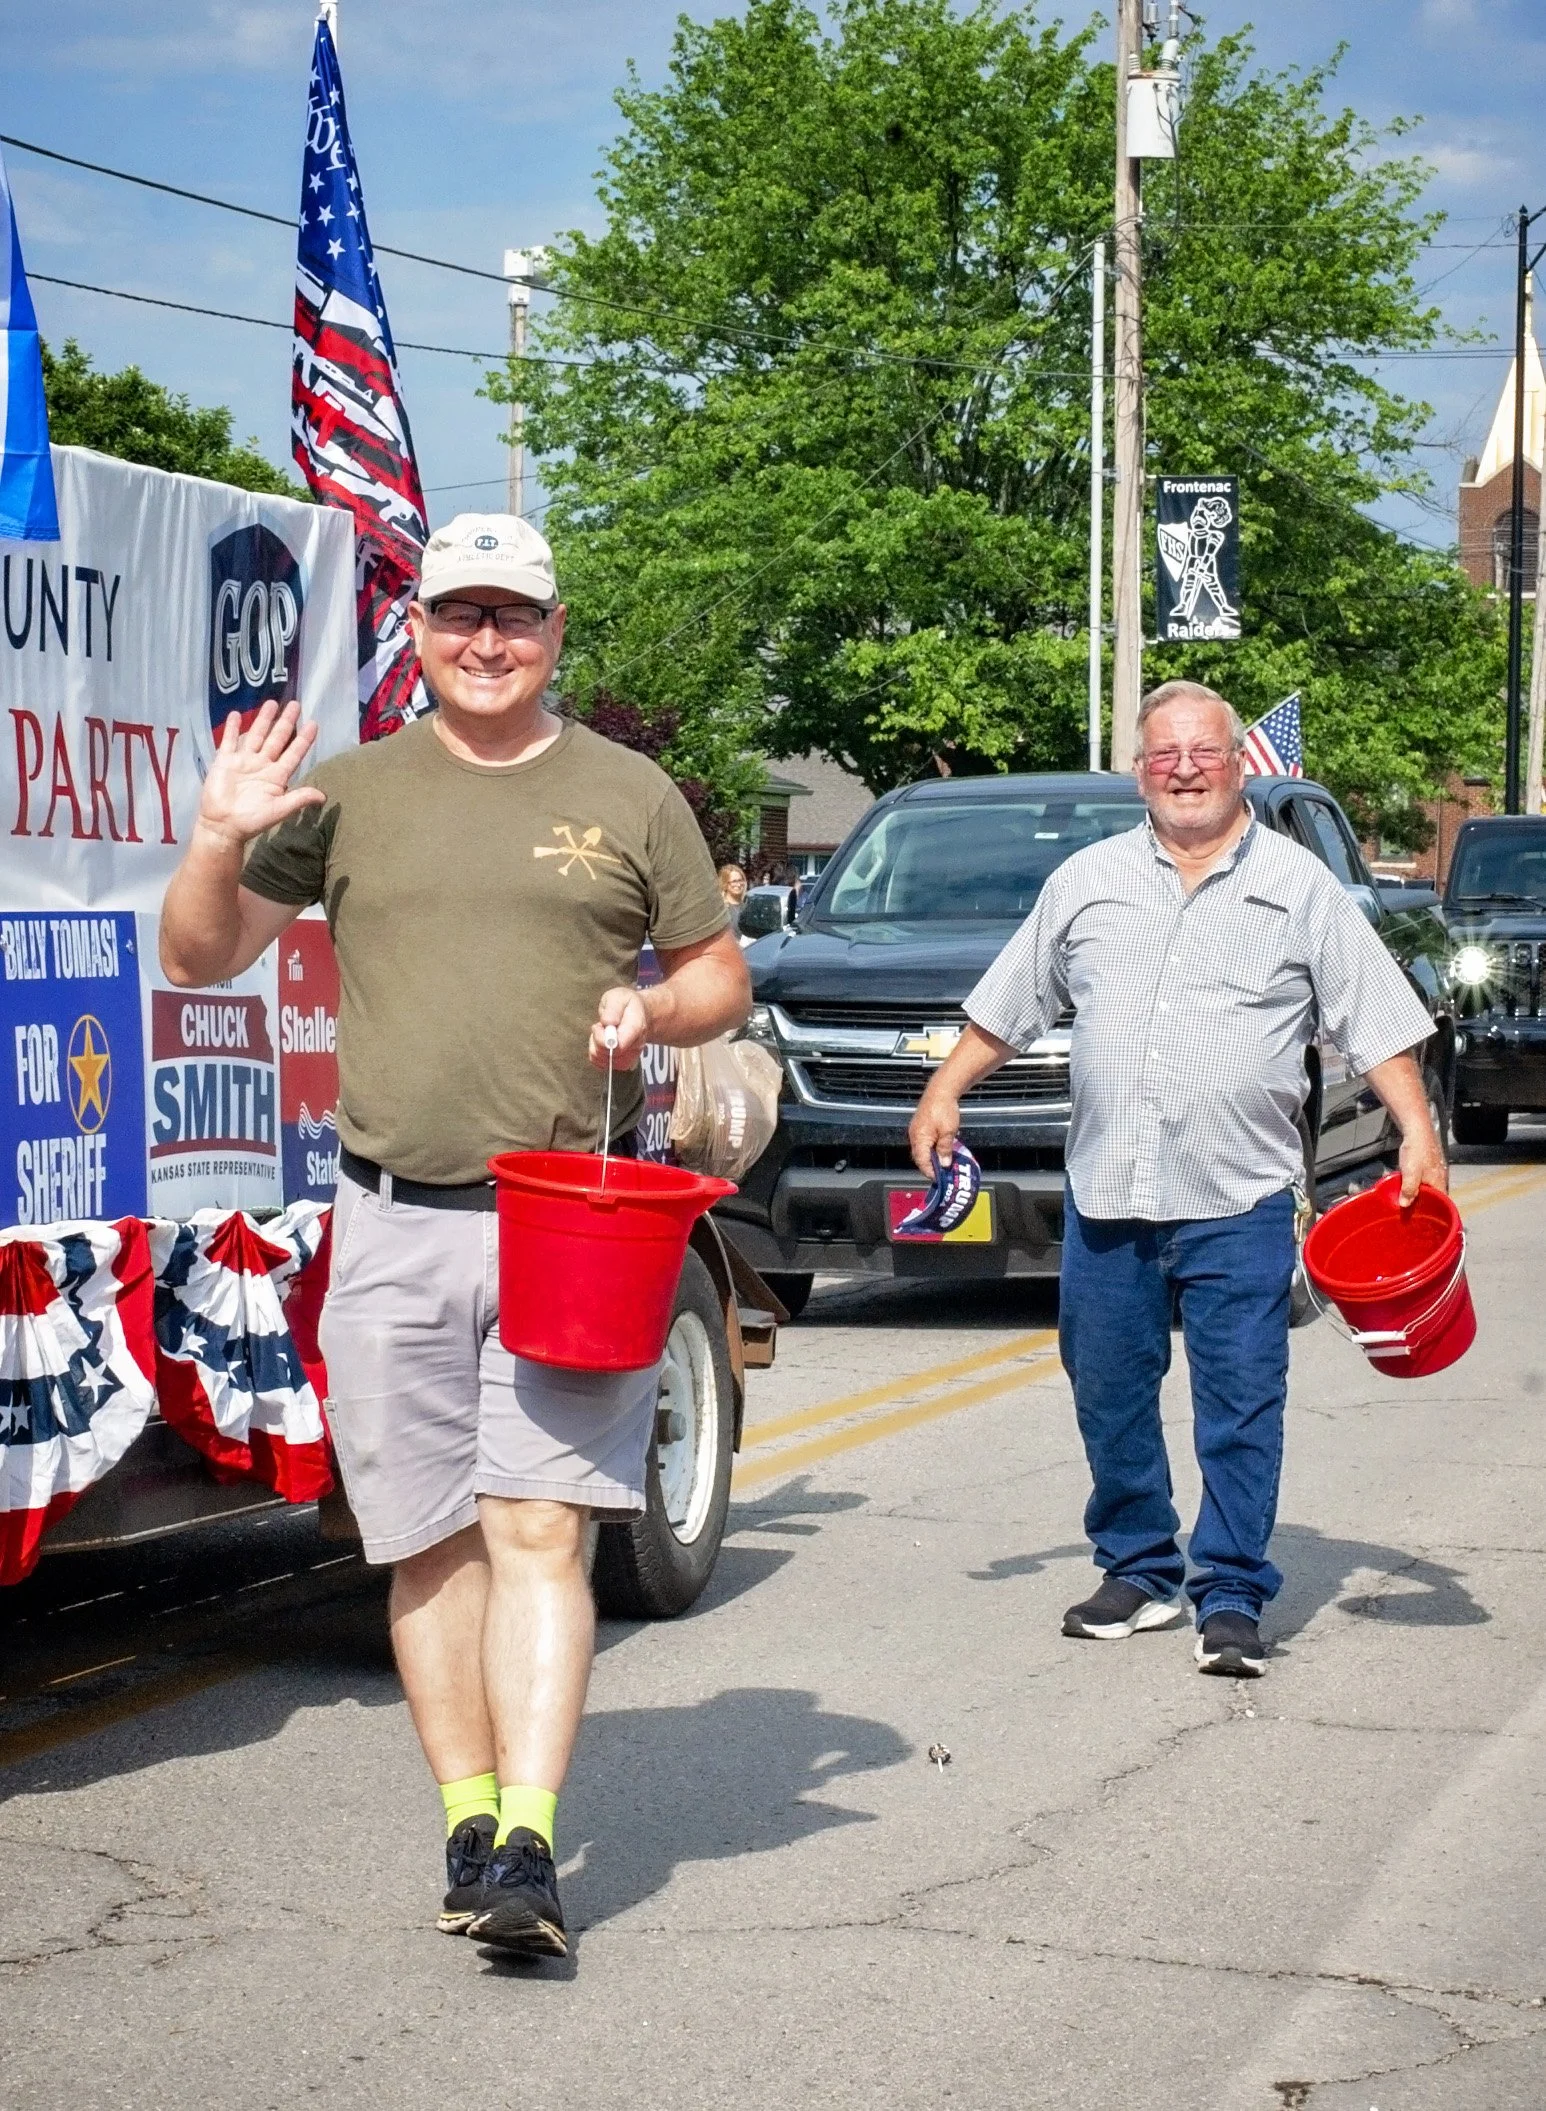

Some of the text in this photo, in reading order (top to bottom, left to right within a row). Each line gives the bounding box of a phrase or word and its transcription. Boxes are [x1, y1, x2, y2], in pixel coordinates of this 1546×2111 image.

[1163, 480, 1232, 494] Frontenac
[1160, 531, 1185, 561] FHS
[3, 554, 121, 662] UNTY
[213, 578, 300, 694] GOP
[1167, 621, 1231, 638] Raide
[9, 707, 180, 845] PARTY
[1, 918, 120, 981] BILLY TOMASI
[180, 1003, 250, 1049] CHUCK
[281, 1004, 338, 1054] Shalle
[15, 1023, 60, 1106] FOR
[152, 1063, 275, 1146] SMITH
[646, 1111, 672, 1152] 202
[727, 1089, 747, 1149] TRUMP
[16, 1132, 108, 1225] SHERIFF
[151, 1160, 276, 1184] KANSAS STATE REPRESENTATIVE
[939, 1164, 972, 1228] TRUMP
